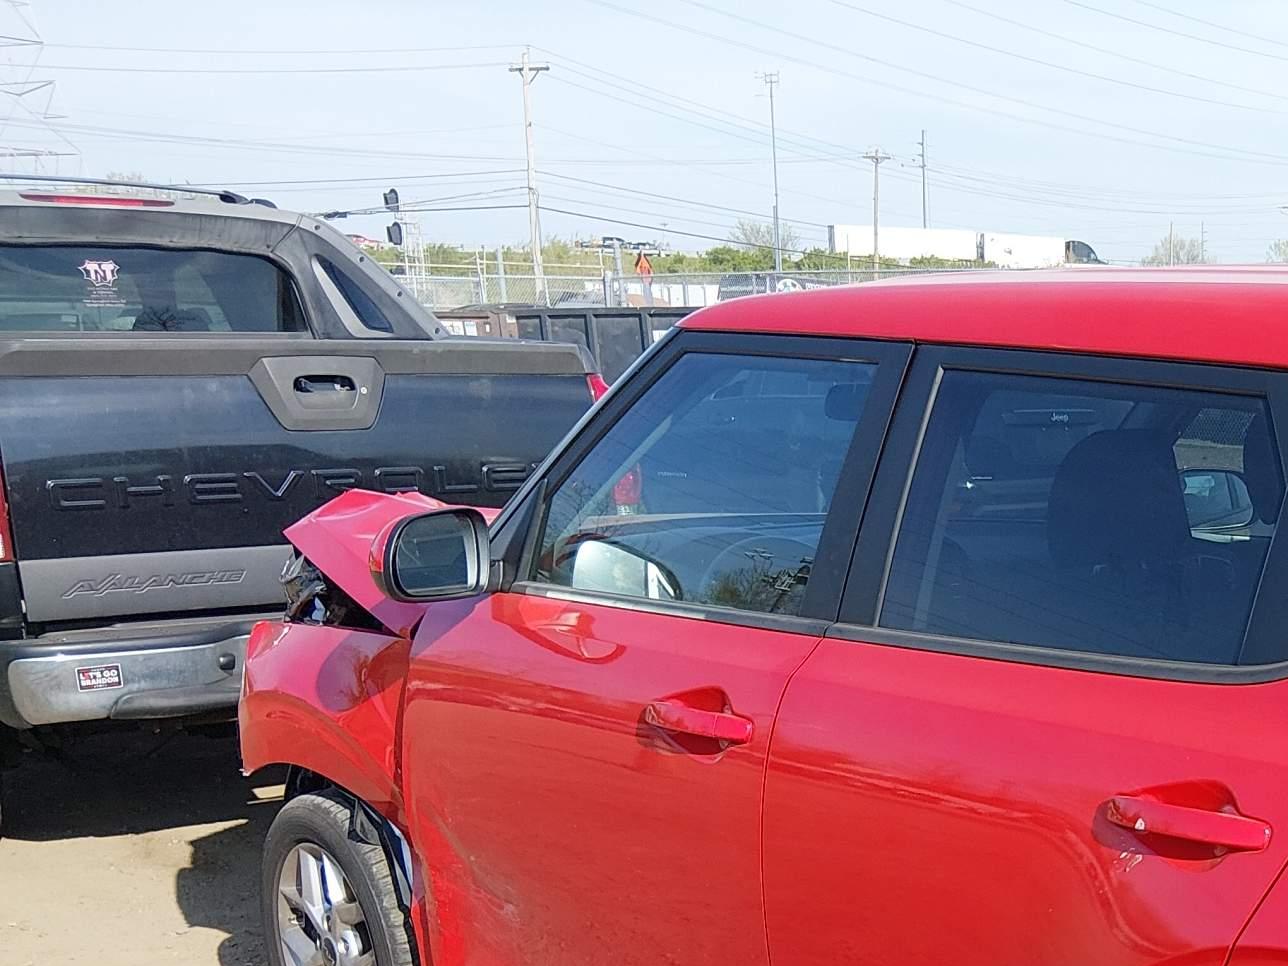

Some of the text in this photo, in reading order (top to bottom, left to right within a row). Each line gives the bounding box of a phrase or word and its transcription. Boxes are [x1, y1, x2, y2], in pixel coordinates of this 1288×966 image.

[45, 463, 537, 508] CHEVROLE
[63, 568, 247, 599] AVALANCHE
[103, 669, 117, 678] GO
